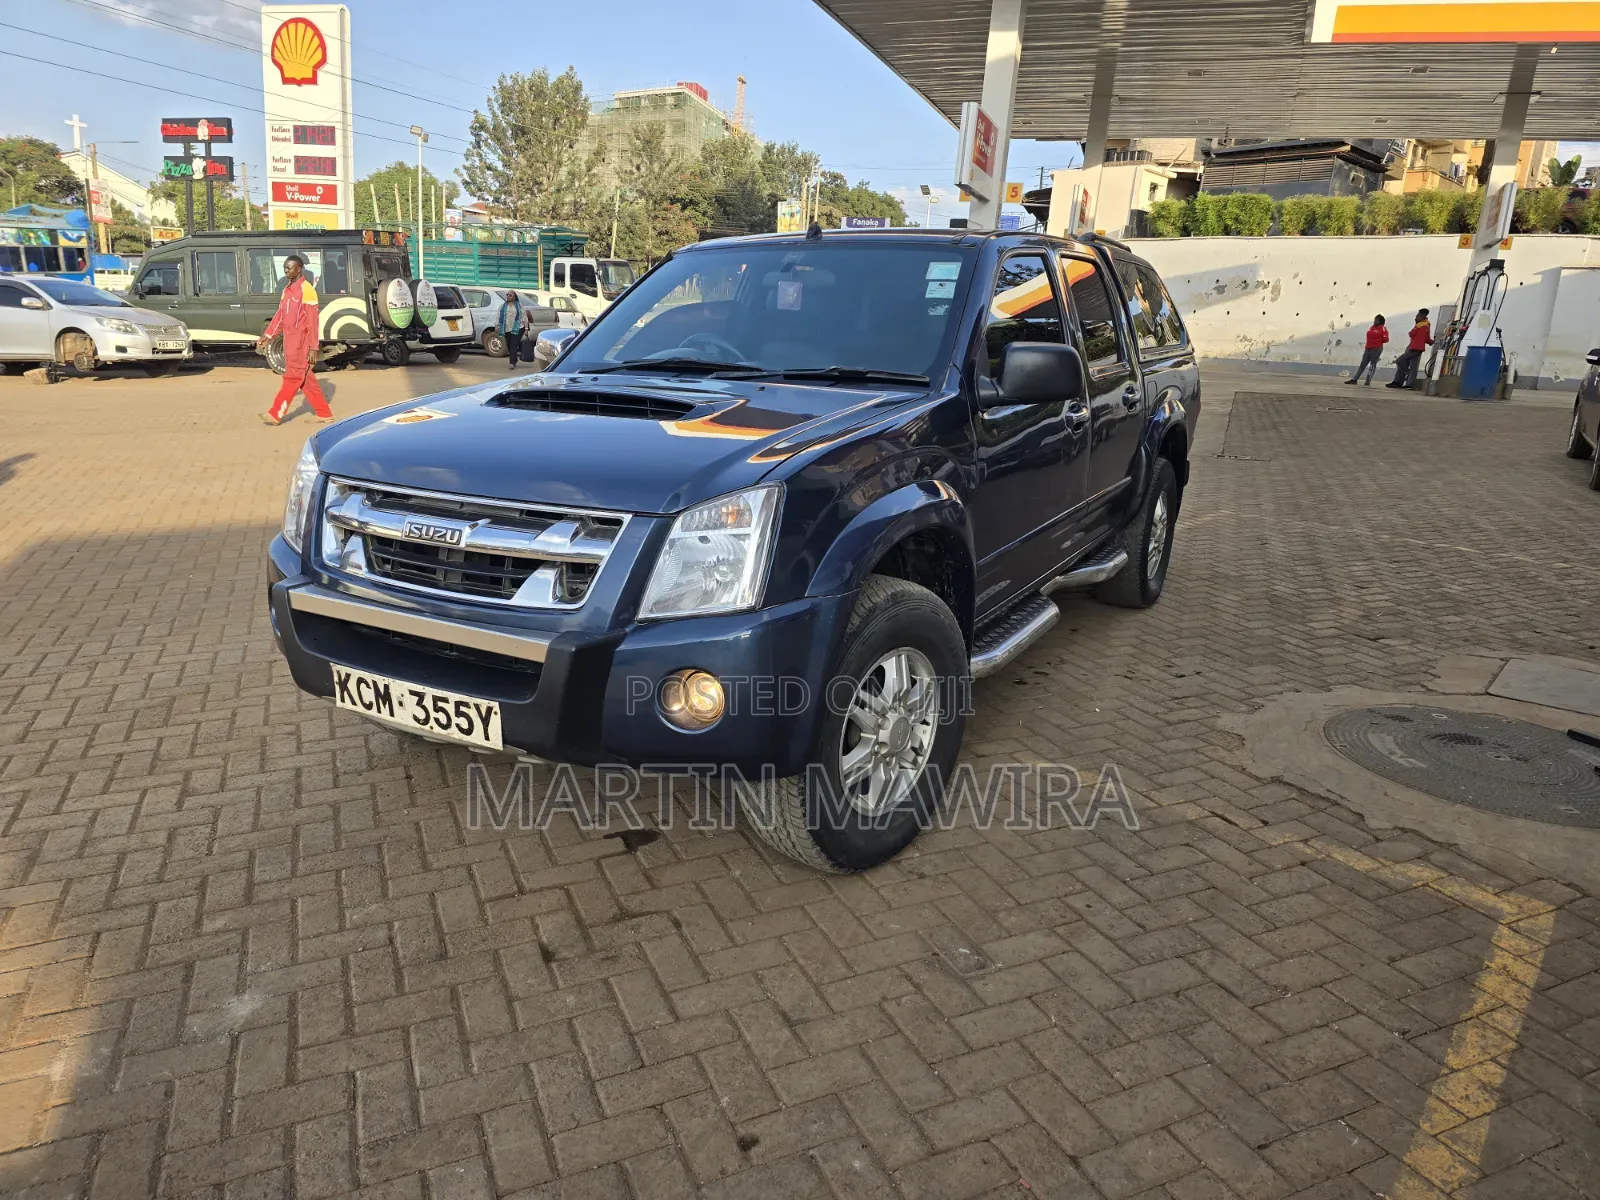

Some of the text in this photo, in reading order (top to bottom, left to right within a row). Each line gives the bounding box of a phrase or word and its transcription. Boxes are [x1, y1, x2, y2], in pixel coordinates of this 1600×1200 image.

[163, 160, 228, 177] Pizza Inn
[272, 165, 287, 173] Diesel
[285, 192, 321, 202] V-Power
[1010, 186, 1019, 198] 5
[285, 219, 325, 230] FuelSave
[852, 218, 879, 226] Fanaka
[158, 231, 176, 239] ACK
[1461, 237, 1469, 246] 3
[404, 522, 461, 544] ISUZU
[336, 670, 494, 741] KCM 355Y
